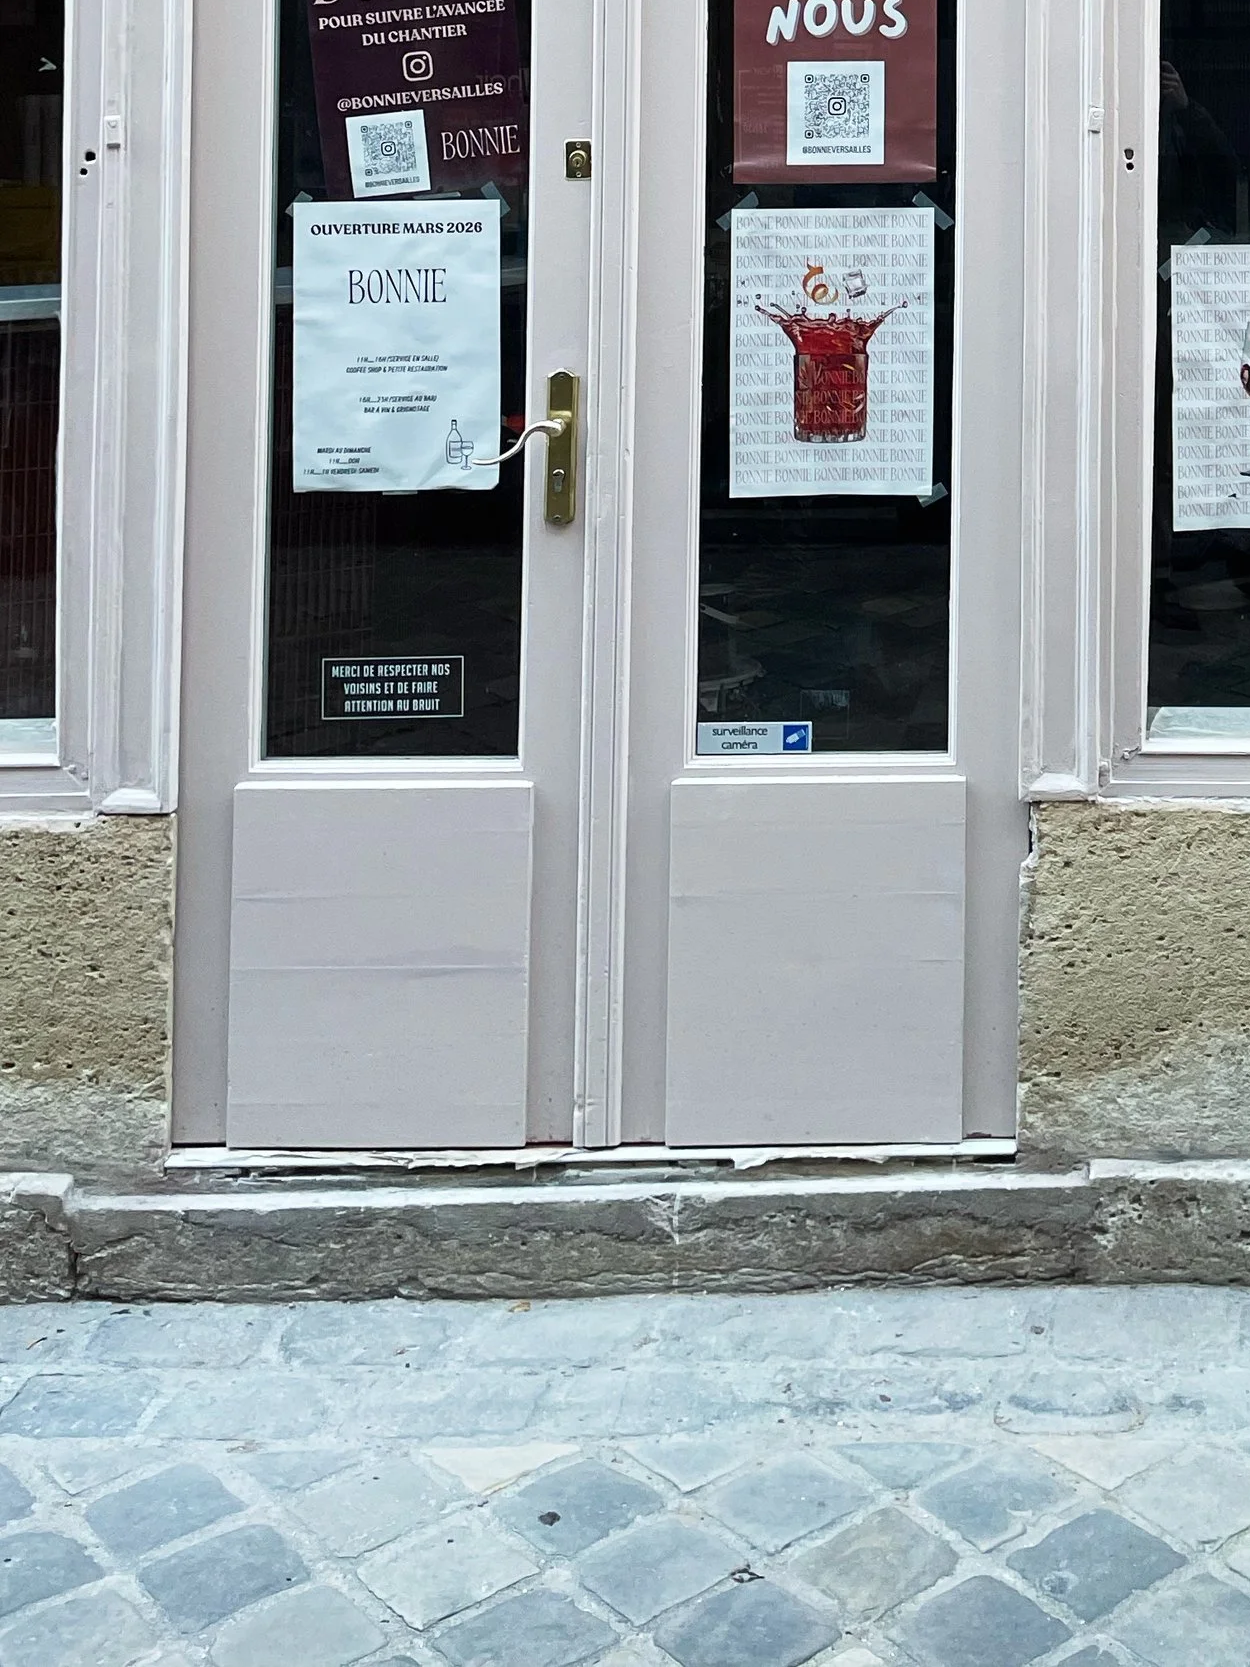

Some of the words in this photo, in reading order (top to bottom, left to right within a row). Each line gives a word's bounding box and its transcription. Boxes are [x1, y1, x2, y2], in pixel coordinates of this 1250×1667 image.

[319, 14, 363, 30] POUR
[366, 8, 423, 26] SUIVRE
[362, 34, 386, 46] DU
[388, 24, 467, 43] CHANTIER
[337, 82, 503, 112] @BONNIEVERSAILLES
[441, 125, 520, 160] BONNIE
[311, 223, 400, 236] OUVERTURE
[402, 222, 444, 234] MARS
[447, 222, 482, 234] 2026
[349, 268, 447, 304] BONNIE
[332, 666, 360, 678] MERCI
[364, 665, 374, 677] DE
[378, 664, 428, 677] RESPECTER
[432, 664, 450, 676] NOS
[344, 683, 381, 695] VOISINS
[384, 682, 394, 694] ET
[398, 682, 408, 694] DE
[412, 681, 438, 693] FAIRE
[345, 700, 394, 713] ATTENTION
[397, 699, 409, 712] AU
[413, 699, 440, 711] BRUIT
[712, 725, 768, 737] surveillance
[721, 739, 758, 750] caméra
